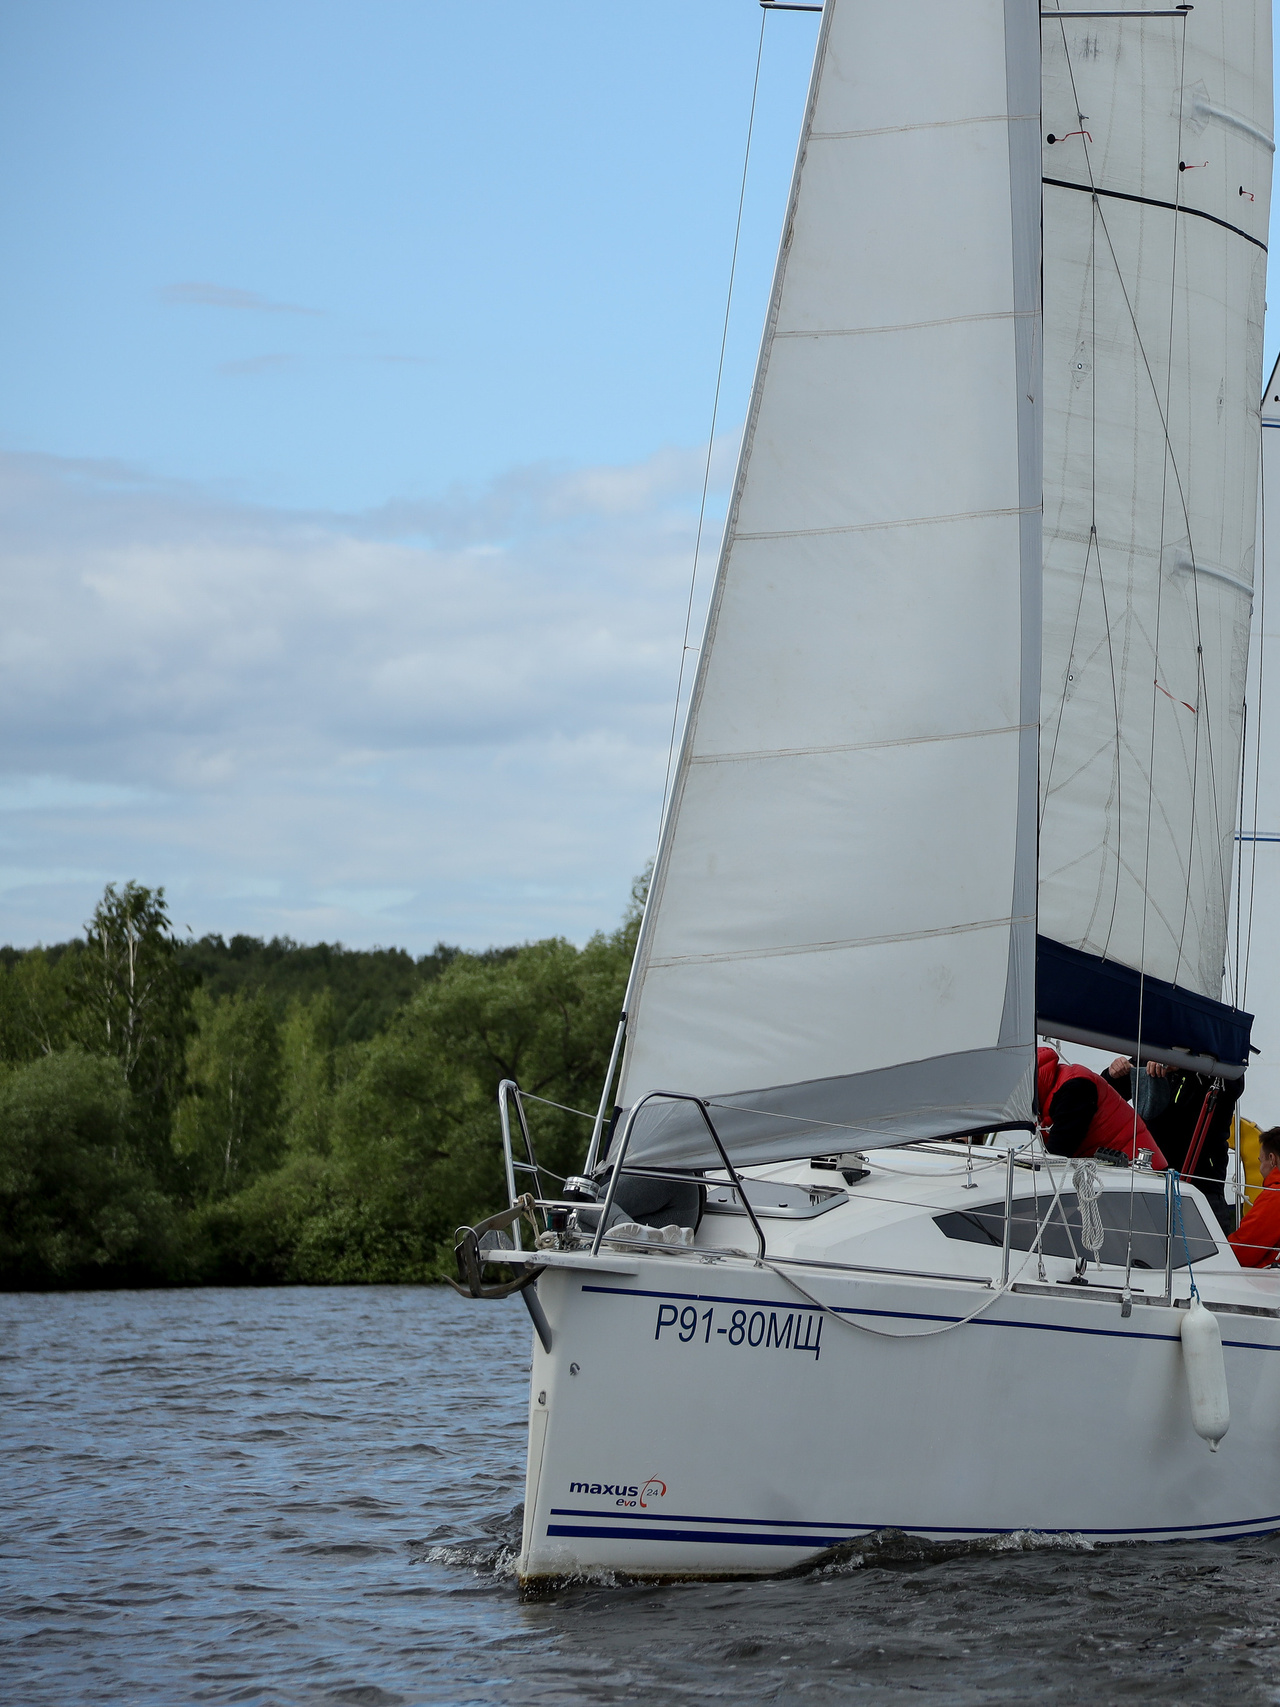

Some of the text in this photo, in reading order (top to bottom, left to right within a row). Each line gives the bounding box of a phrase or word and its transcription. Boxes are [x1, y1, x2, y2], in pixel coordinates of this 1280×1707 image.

[655, 1304, 823, 1360] Р91-80МЩ
[569, 1482, 659, 1497] maxus 24
[615, 1498, 637, 1507] evo
